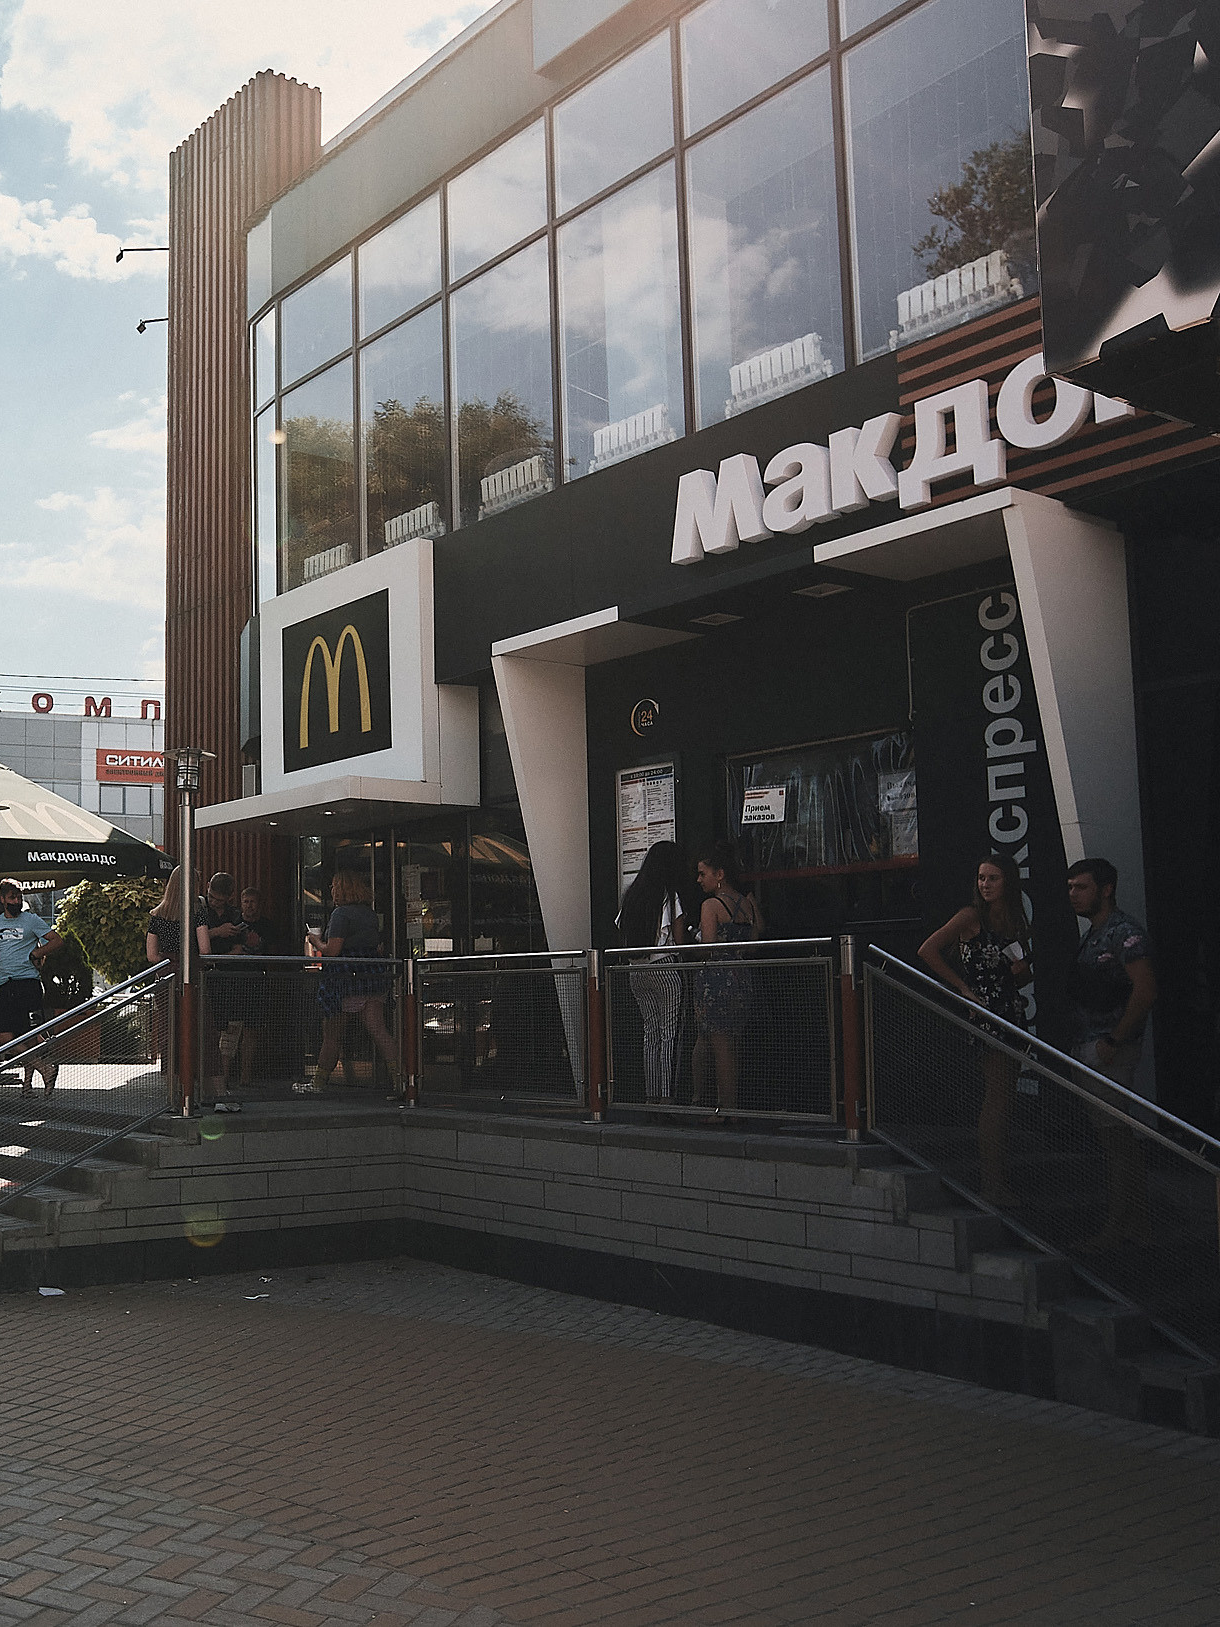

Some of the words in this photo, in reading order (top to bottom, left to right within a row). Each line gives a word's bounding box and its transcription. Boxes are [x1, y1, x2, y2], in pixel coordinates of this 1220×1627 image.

[640, 709, 653, 722] 24
[105, 754, 164, 768] СИТИЛ
[745, 805, 771, 813] Прием
[744, 814, 776, 822] заказов
[27, 851, 117, 865] Макдоналдс
